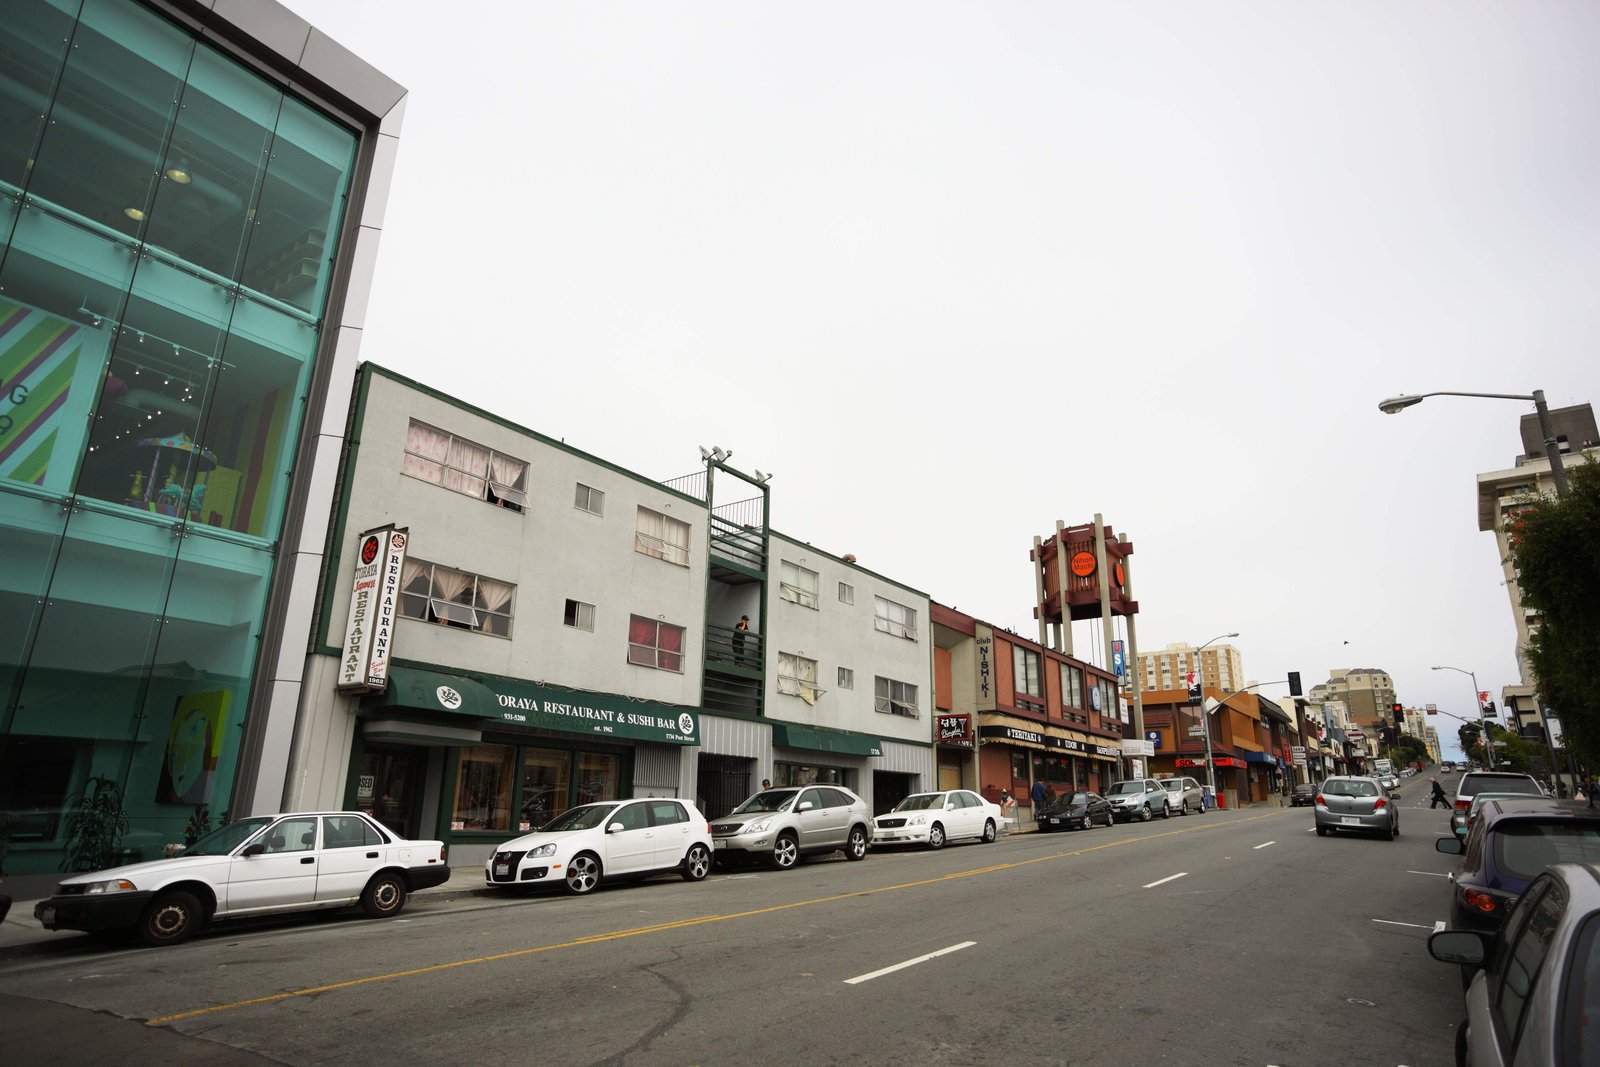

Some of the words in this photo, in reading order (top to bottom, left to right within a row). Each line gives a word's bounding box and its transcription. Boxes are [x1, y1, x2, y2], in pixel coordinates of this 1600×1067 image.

[355, 563, 378, 580] TORAYA
[353, 579, 376, 592] Japanese
[377, 554, 399, 659] RESTAURANT
[344, 591, 369, 682] RESTAURANT
[976, 637, 991, 645] club
[1113, 641, 1122, 676] USA
[980, 646, 990, 698] NISHIKI
[368, 677, 384, 685] 1962
[496, 693, 539, 711] ORAYA
[543, 701, 614, 722] RESTAURANT
[616, 712, 625, 723] &
[627, 713, 655, 727] SUSHI
[657, 717, 676, 730] BAR
[503, 713, 526, 722] 931-5200
[1011, 729, 1037, 742] TERIYAKI
